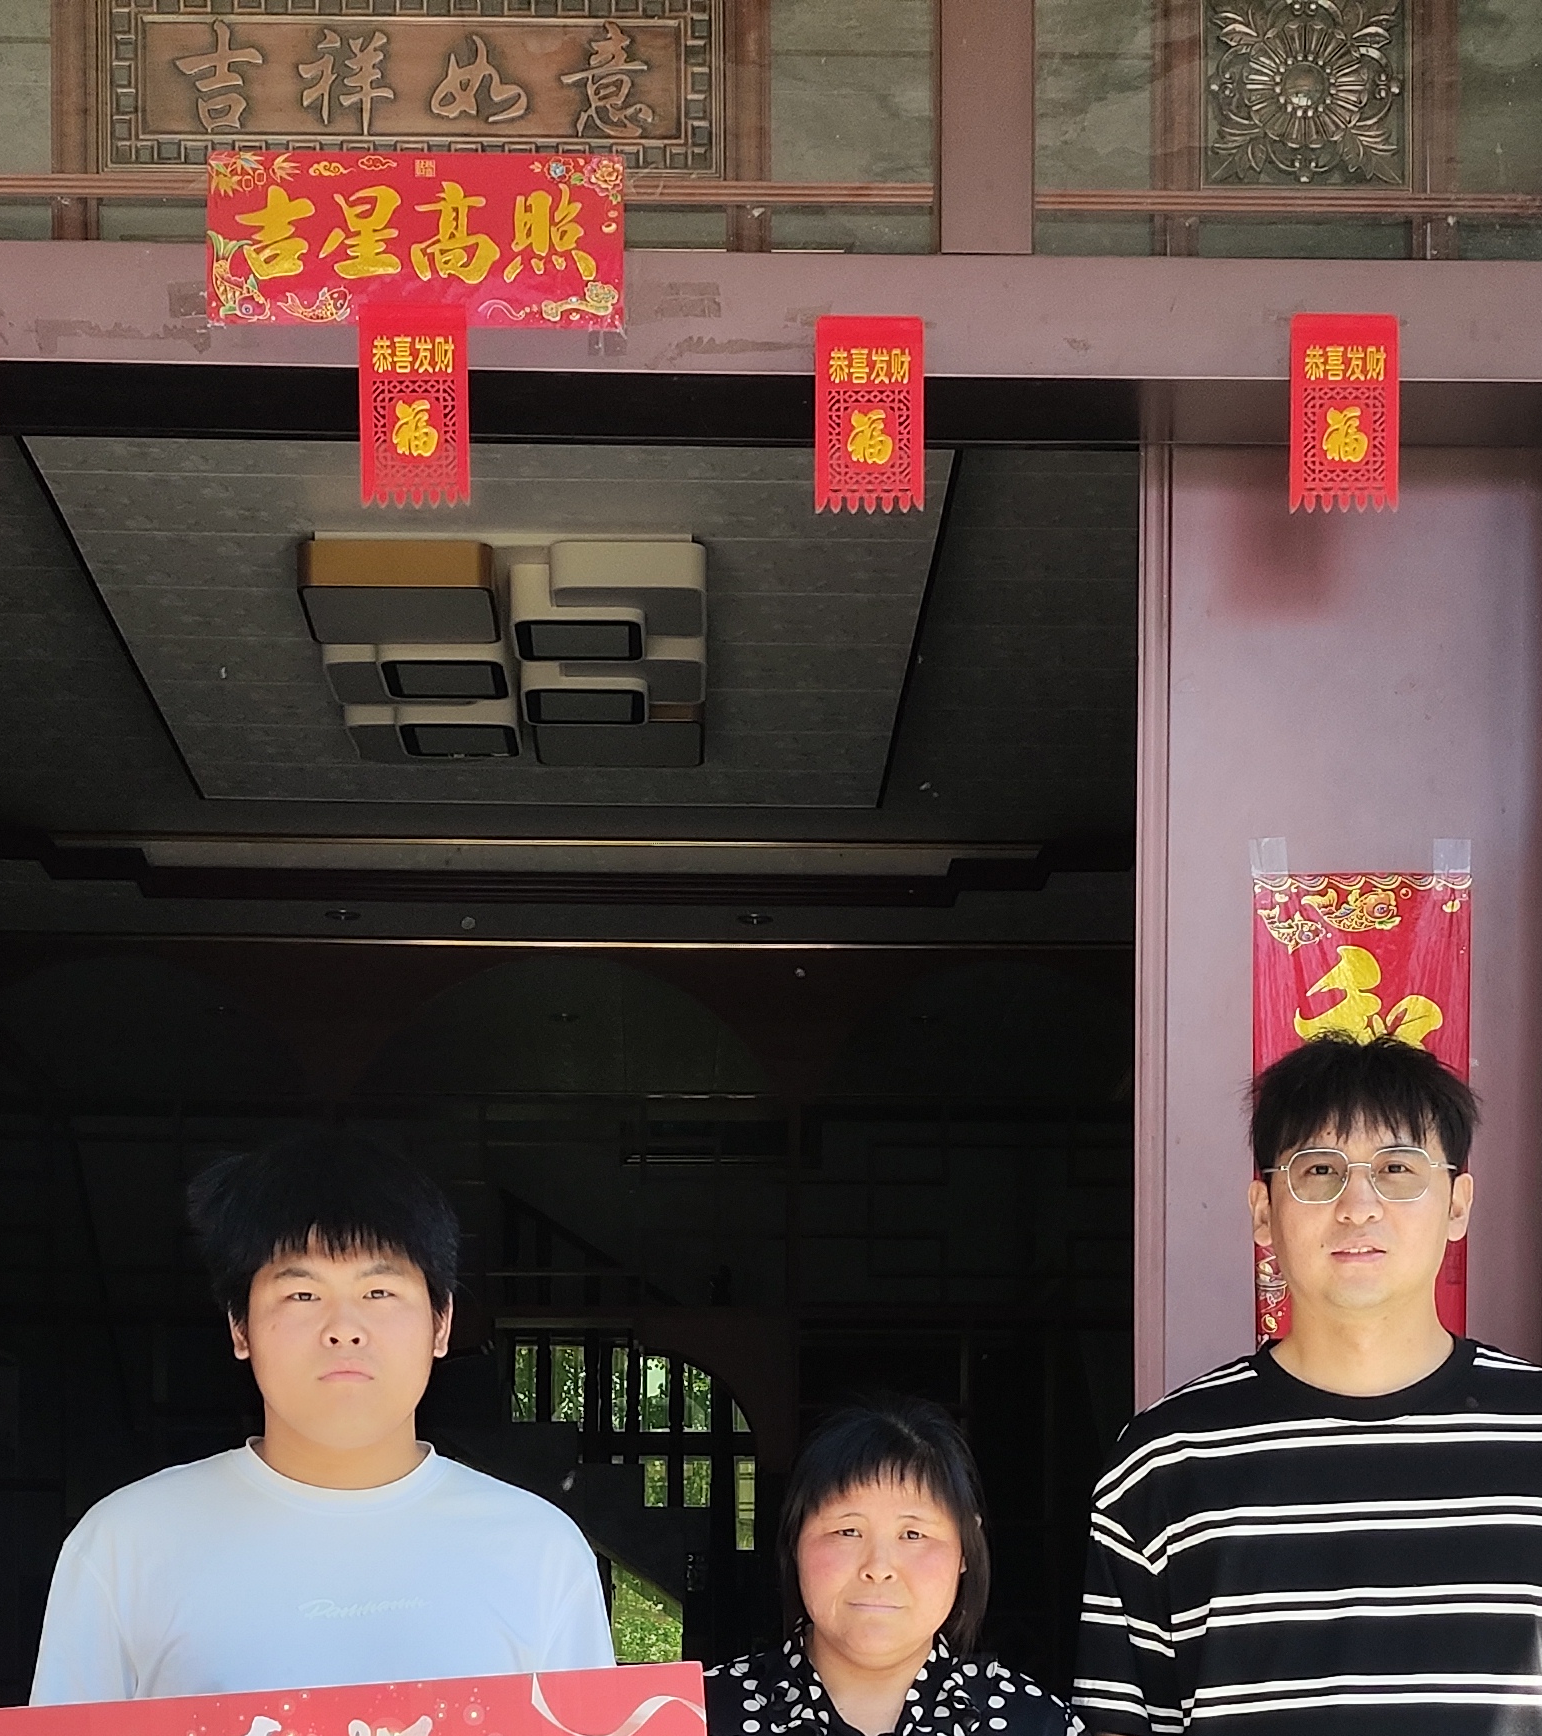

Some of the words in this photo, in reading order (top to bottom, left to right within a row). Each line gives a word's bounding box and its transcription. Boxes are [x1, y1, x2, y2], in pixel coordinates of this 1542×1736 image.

[175, 19, 654, 137] 吉祥如意
[235, 181, 597, 285] 吉星高照
[372, 335, 454, 374] 恭喜发财
[829, 346, 911, 384] 恭喜发财
[1304, 345, 1386, 381] 恭喜发财
[393, 399, 439, 458] 福
[848, 408, 894, 465] 福
[1322, 406, 1368, 463] 福
